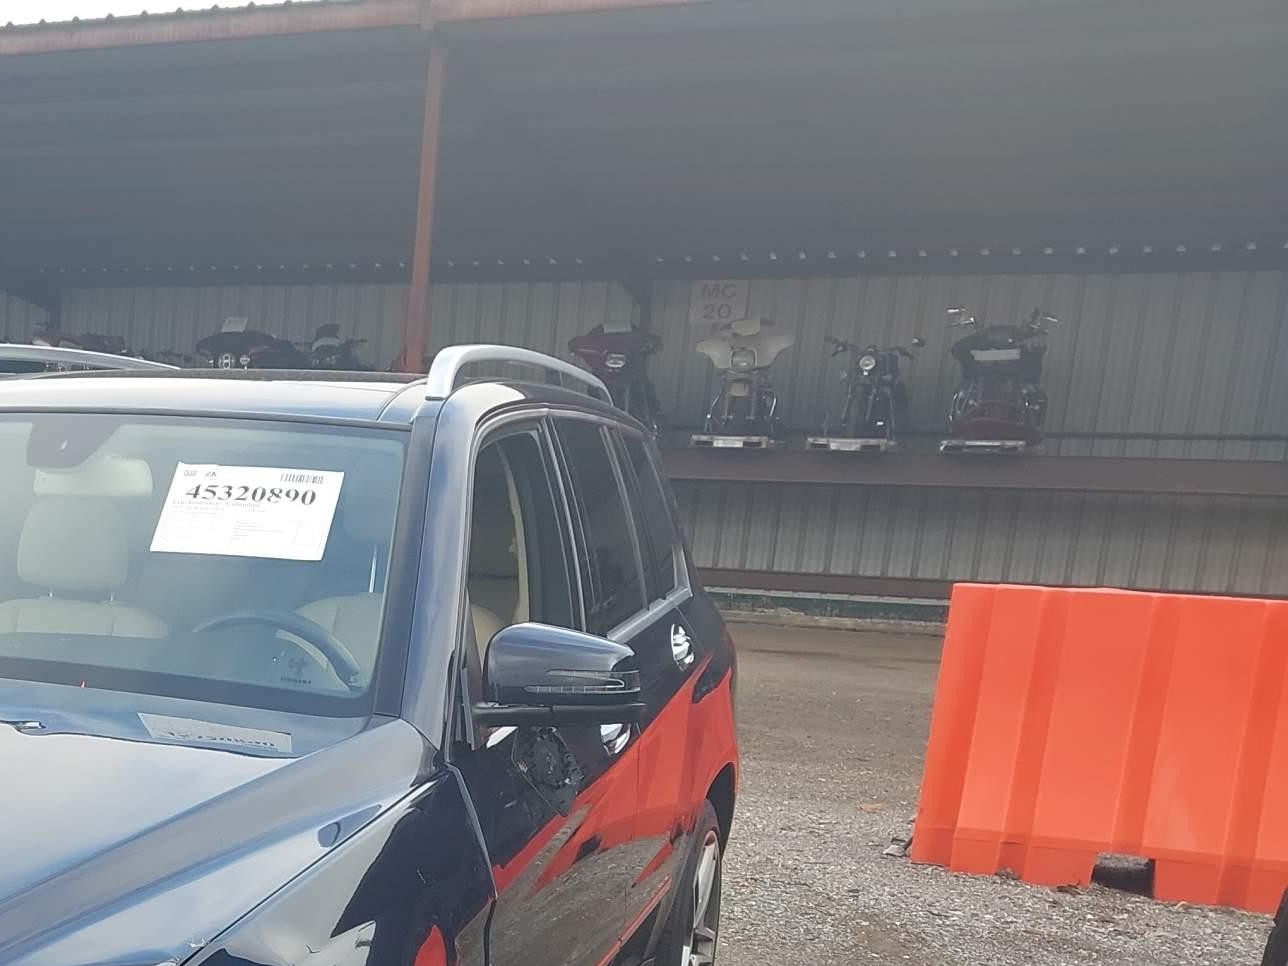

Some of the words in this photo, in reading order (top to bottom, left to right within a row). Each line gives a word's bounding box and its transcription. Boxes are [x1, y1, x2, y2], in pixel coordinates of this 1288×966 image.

[701, 283, 738, 298] MC
[702, 303, 732, 319] 20
[185, 483, 317, 506] 45320890
